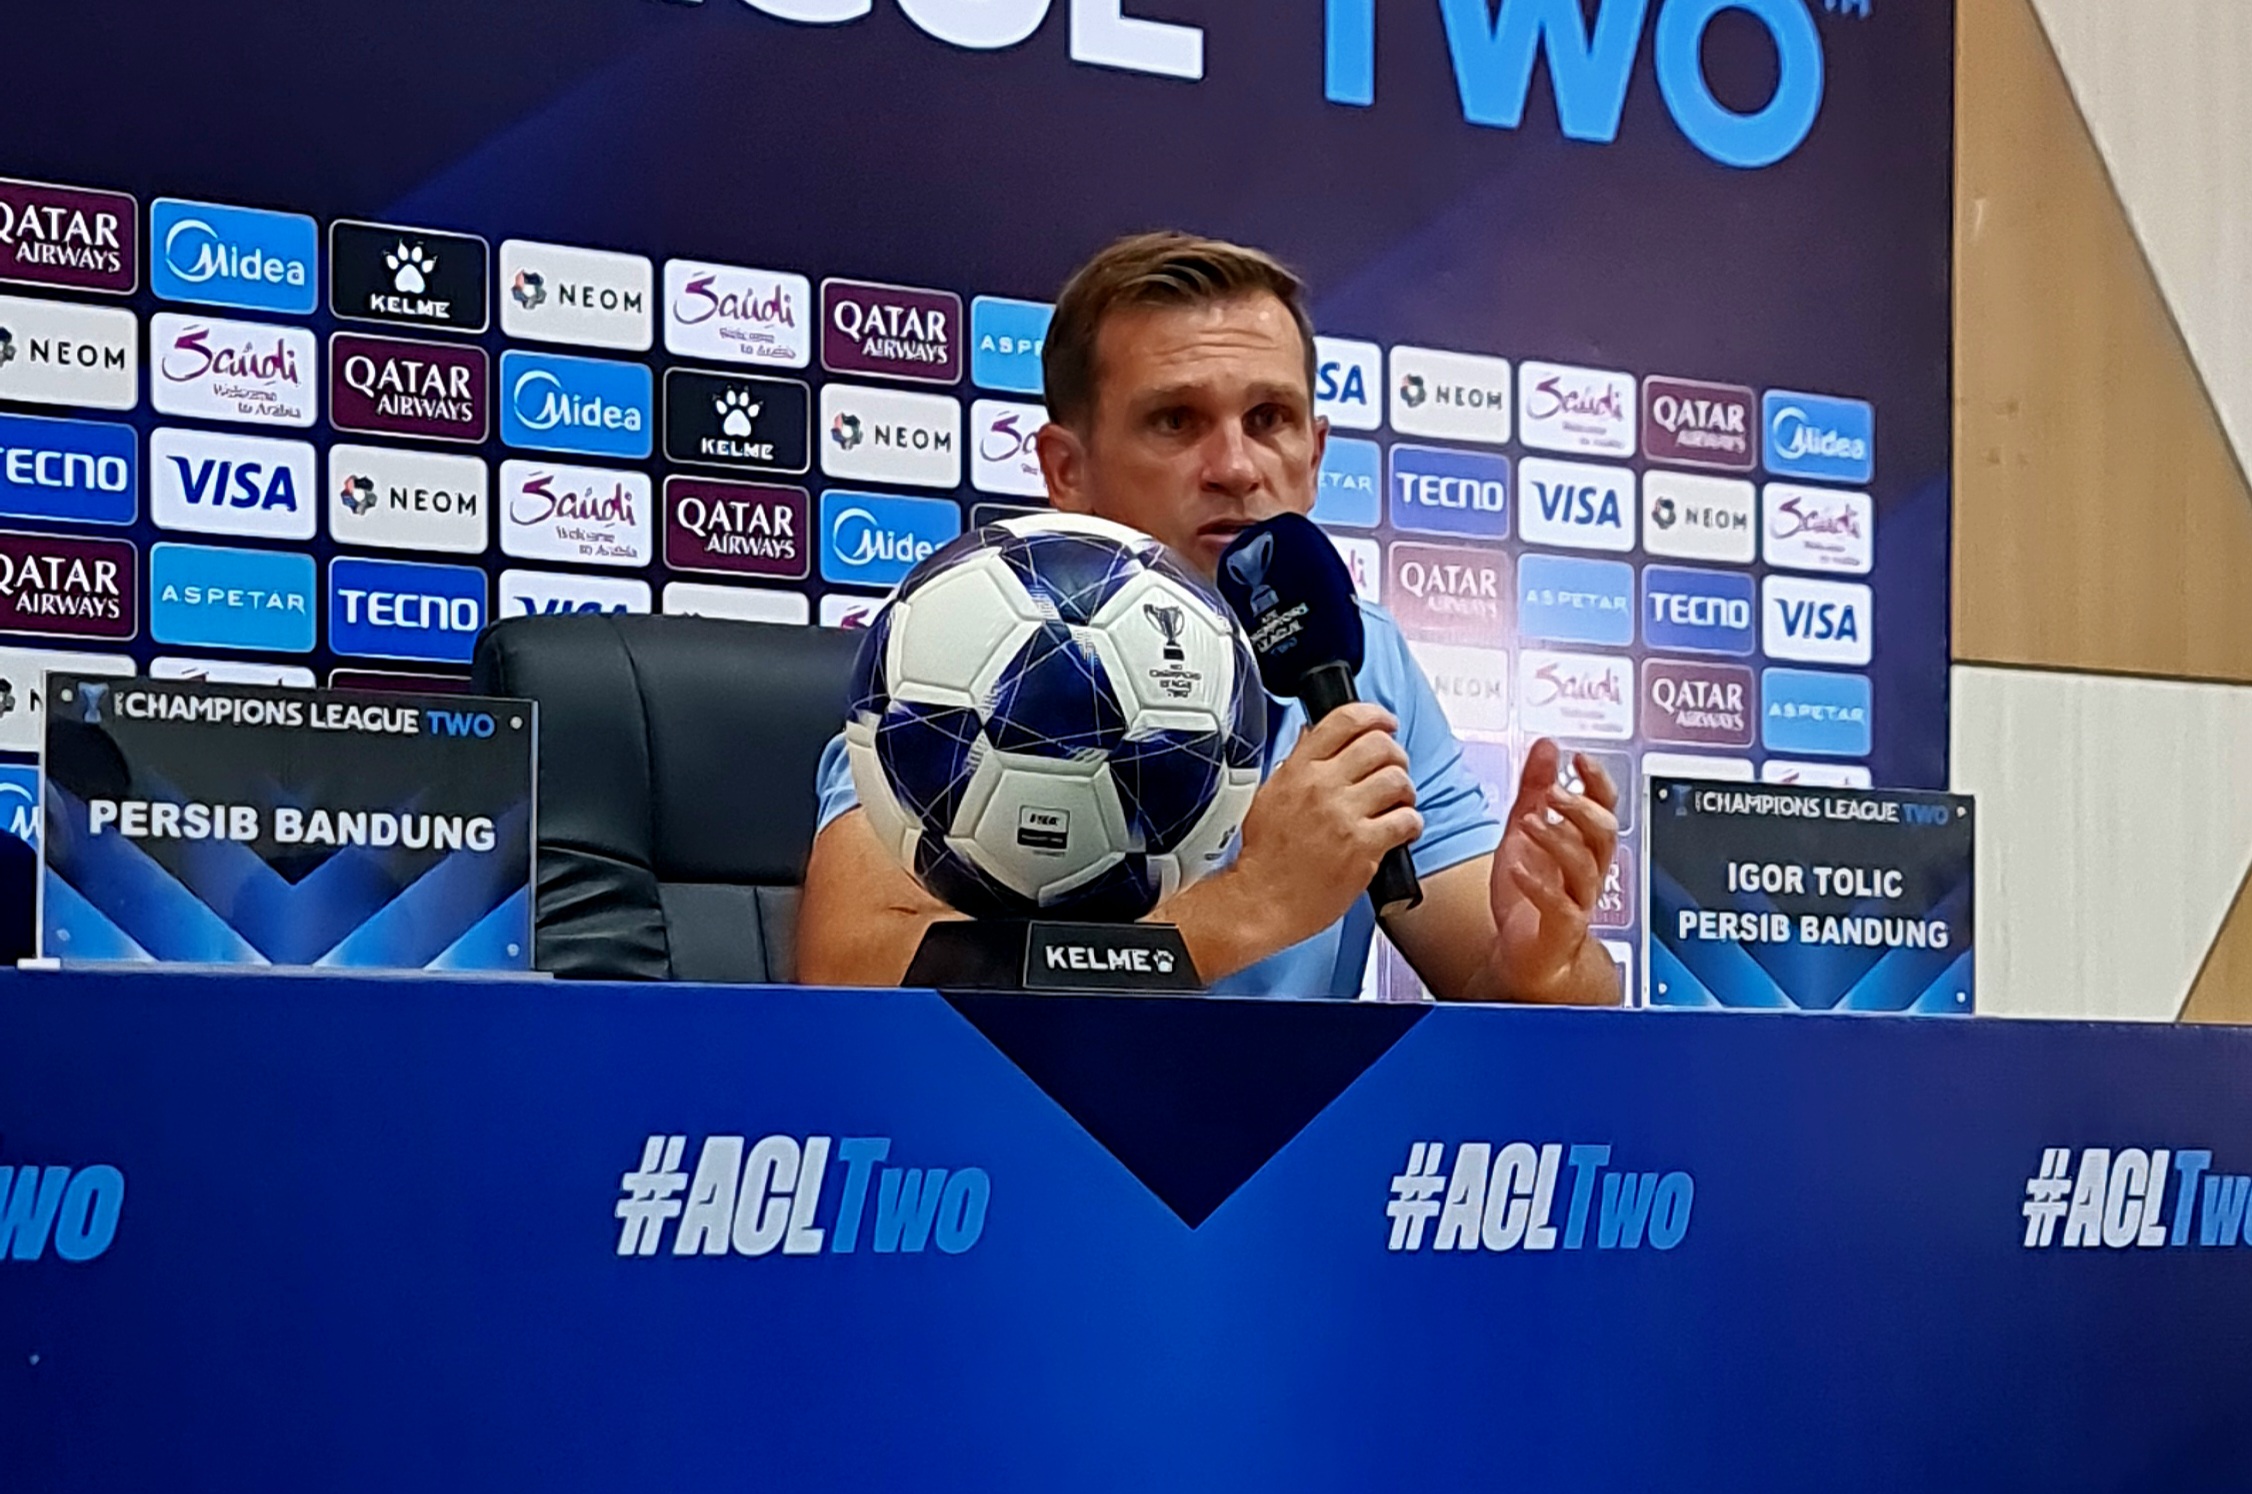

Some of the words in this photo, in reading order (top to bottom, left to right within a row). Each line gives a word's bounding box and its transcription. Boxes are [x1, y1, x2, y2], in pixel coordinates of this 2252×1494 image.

[15, 241, 121, 273] AIRWAYS
[370, 293, 451, 319] KELME
[559, 283, 642, 314] NEOM
[673, 275, 795, 328] Saudi
[833, 300, 947, 342] QATAR
[30, 338, 125, 370] NEOM
[162, 328, 298, 384] Saudi
[862, 337, 948, 364] AIRWAYS
[345, 356, 471, 399] QATAR
[1316, 361, 1367, 405] SA
[376, 397, 473, 423] AIRWAYS
[1436, 383, 1502, 410] NEOM
[1653, 395, 1745, 433] QATAR
[701, 437, 774, 460] KELME
[874, 424, 952, 453] NEOM
[0, 446, 128, 492] ECNO
[166, 455, 297, 513] VISA
[390, 486, 477, 517] NEOM
[510, 475, 636, 526] Saudi
[1396, 473, 1503, 512] TECNO
[1531, 480, 1622, 529] VISA
[677, 497, 794, 539] QATAR
[1686, 507, 1747, 530] NEOM
[705, 533, 796, 561] AIRWAYS
[1400, 561, 1497, 598] QATAR
[16, 591, 120, 618] AIRWAYS
[161, 584, 306, 615] ASPETAR
[338, 588, 478, 632] TECNO
[1525, 589, 1630, 615] ASPETAR
[1648, 592, 1750, 630] TECNO
[1773, 598, 1858, 643] VISA
[125, 691, 303, 726] CHAMPIONS
[310, 704, 419, 734] LEAGUE
[428, 711, 495, 738] TWO
[1652, 678, 1744, 715] QATAR
[1768, 702, 1865, 725] ASPETAR
[89, 799, 259, 843] PERSIB
[275, 807, 496, 852] BANDUNG
[1703, 791, 1820, 818] CHAMPIONS
[1824, 798, 1900, 822] LEAGUE
[1902, 803, 1949, 826] TWO
[1728, 862, 1803, 896] IGOR
[1813, 866, 1903, 898] TOLIC
[1678, 911, 1790, 943] PERSIB
[1800, 914, 1950, 950] BANDUNG
[1045, 945, 1152, 973] KELME
